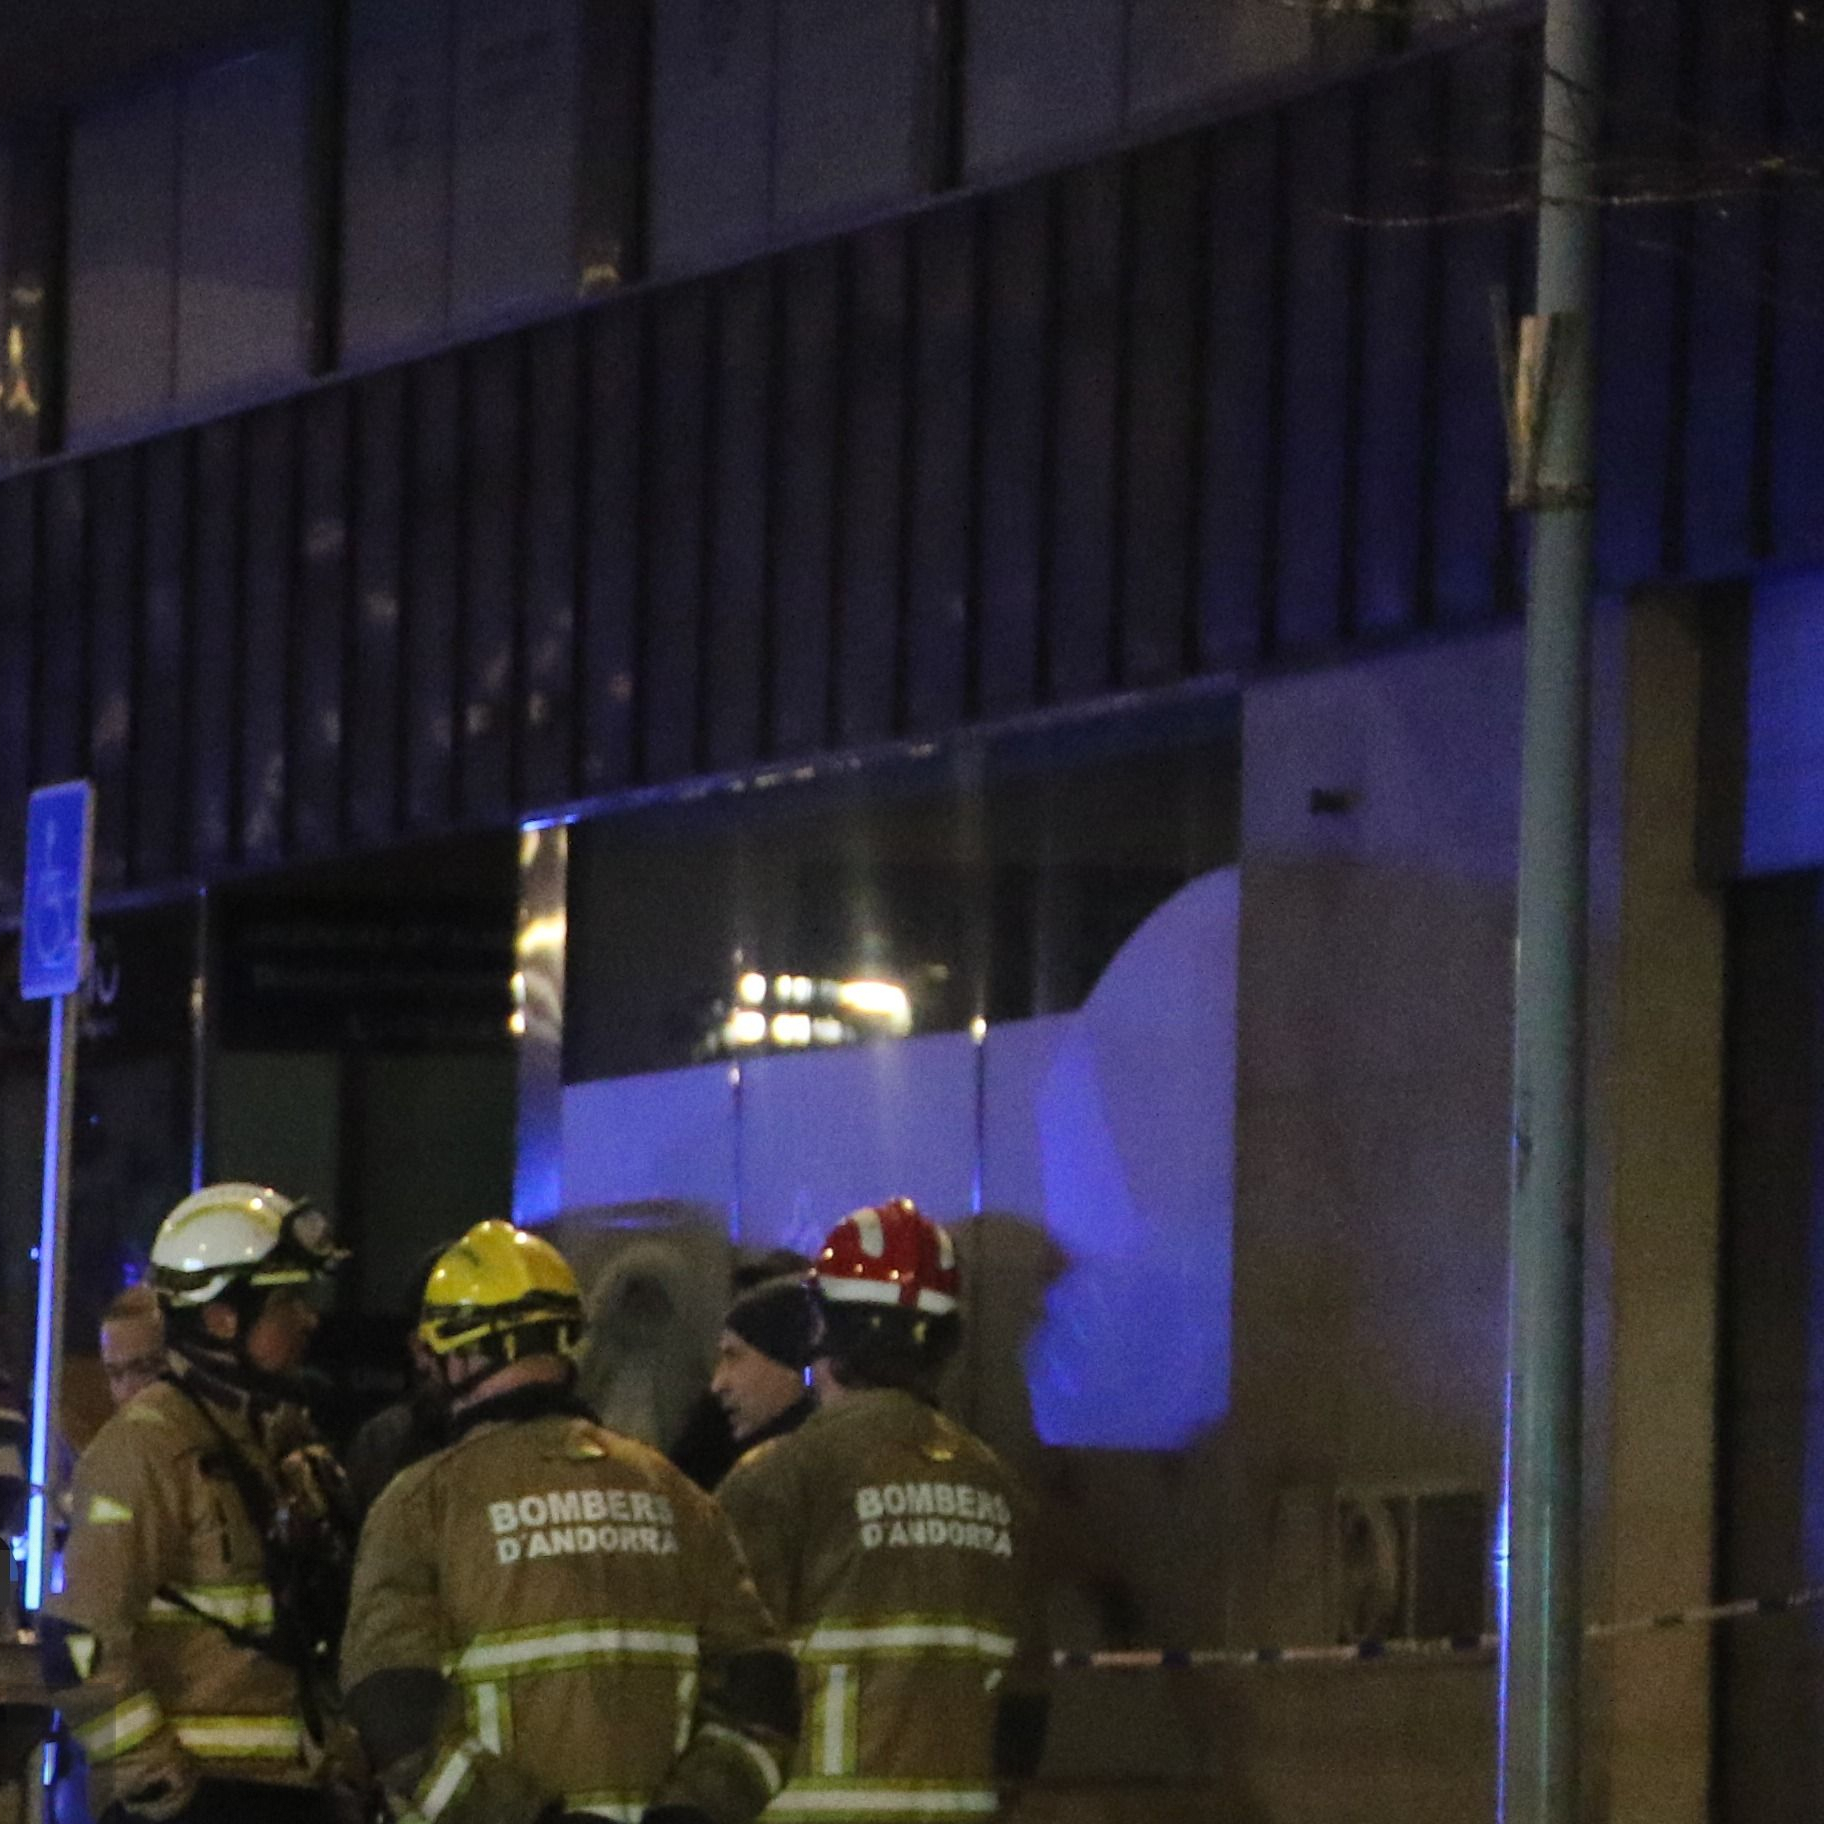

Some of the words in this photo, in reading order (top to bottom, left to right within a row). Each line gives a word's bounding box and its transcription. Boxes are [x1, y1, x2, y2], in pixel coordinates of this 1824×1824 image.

[489, 1489, 673, 1534] BOMBERS
[856, 1483, 1011, 1526] BOMBERS
[495, 1526, 678, 1564] D'ANDORRA
